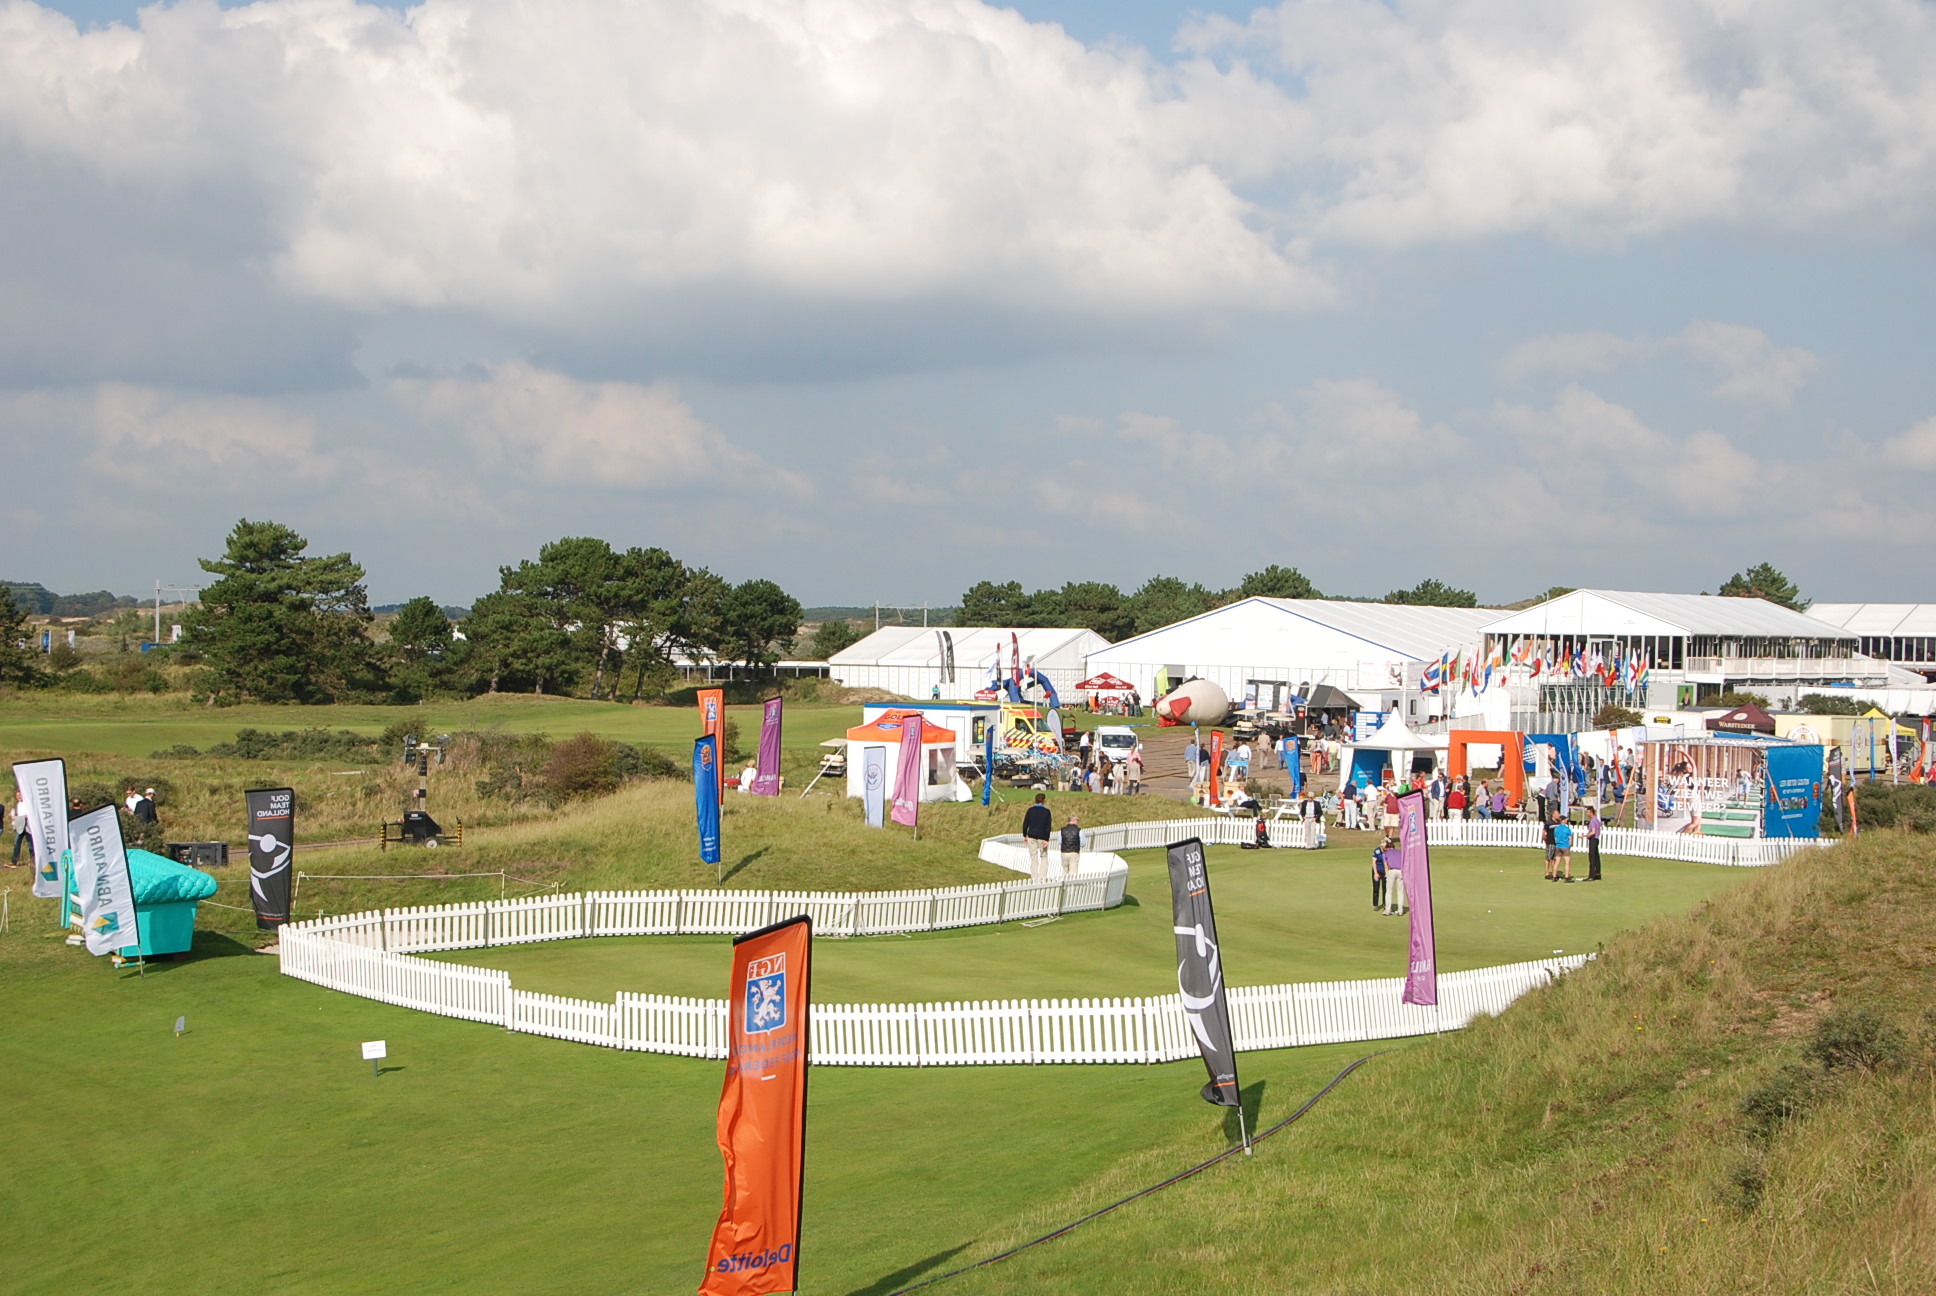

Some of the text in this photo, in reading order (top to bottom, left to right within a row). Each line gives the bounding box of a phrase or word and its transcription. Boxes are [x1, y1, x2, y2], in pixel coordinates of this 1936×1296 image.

[1718, 721, 1756, 729] WARSTEINER
[1668, 774, 1729, 788] WANNEER
[1673, 789, 1723, 800] ZIEN WE
[1670, 802, 1727, 813] JE WEER?
